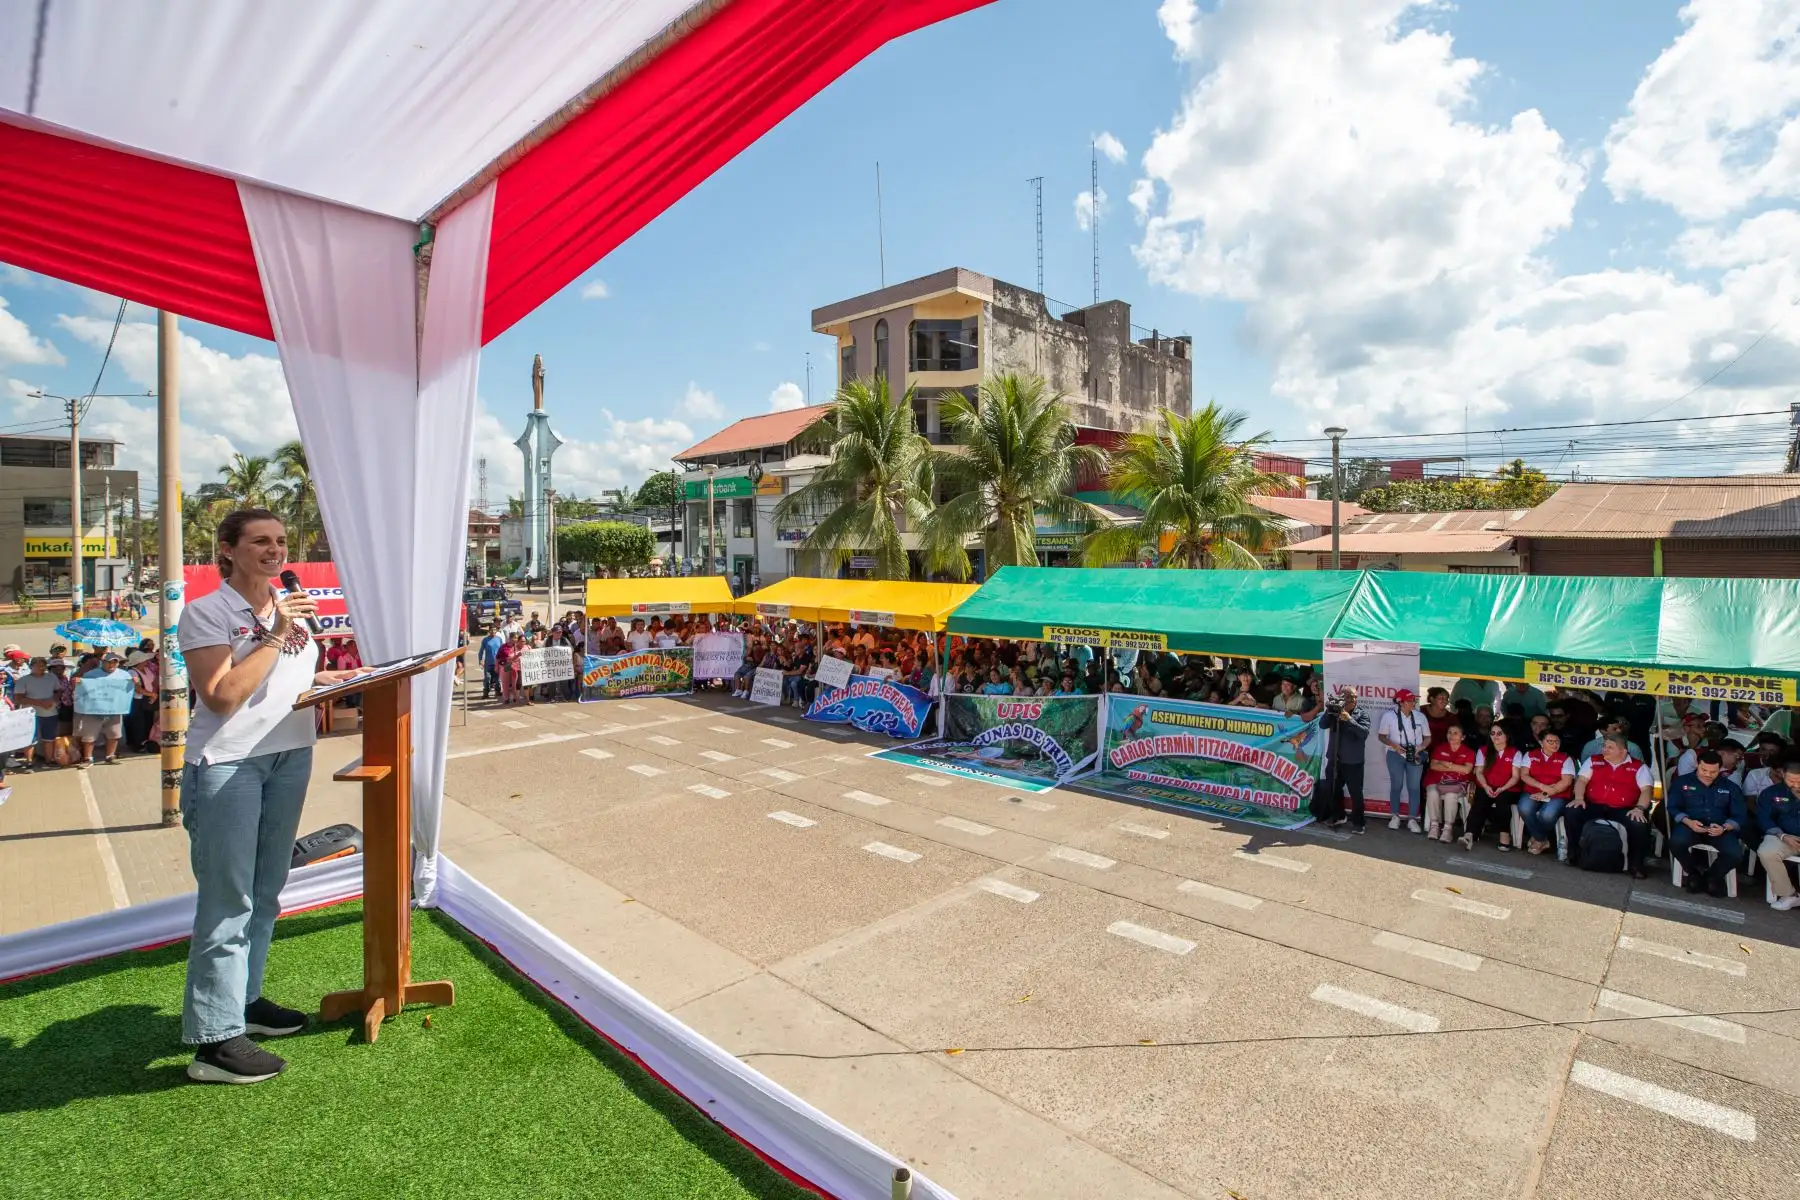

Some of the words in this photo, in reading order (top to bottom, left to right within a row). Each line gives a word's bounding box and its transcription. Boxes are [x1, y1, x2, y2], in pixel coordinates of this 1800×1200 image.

[25, 541, 111, 552] Inkafrm
[1035, 537, 1074, 545] TESANIAS
[1050, 628, 1100, 637] TOLDOS
[1110, 631, 1162, 642] NADINE
[1125, 641, 1138, 649] 992
[524, 668, 573, 683] HUEPETUHE
[584, 665, 611, 687] UPIS
[612, 654, 662, 674] ANTONIA
[1538, 663, 1644, 678] TOLDOS
[1668, 672, 1782, 690] NADINE
[620, 685, 656, 696] PRESENTE
[851, 682, 864, 697] 20
[866, 681, 880, 696] DE
[1332, 683, 1399, 699] VIEND
[1539, 673, 1565, 684] RPC:
[1570, 675, 1592, 686] 987
[1594, 677, 1618, 688] 250
[1621, 680, 1646, 690] 392
[1668, 684, 1696, 696] RPC:
[1702, 686, 1728, 698] 992
[1730, 689, 1755, 701] 522
[1758, 691, 1784, 703] 168
[997, 703, 1042, 720] UPIS
[1151, 711, 1225, 730] ASENTAMIENTO
[1226, 720, 1274, 737] HUMANO
[1022, 724, 1045, 746] DE
[1110, 738, 1154, 768] CARLOS
[1197, 737, 1276, 773] FITZCARRALD
[1273, 755, 1298, 783] KM
[1291, 771, 1313, 796] 23
[1242, 788, 1252, 801] A
[1253, 791, 1300, 811] CUSCO
